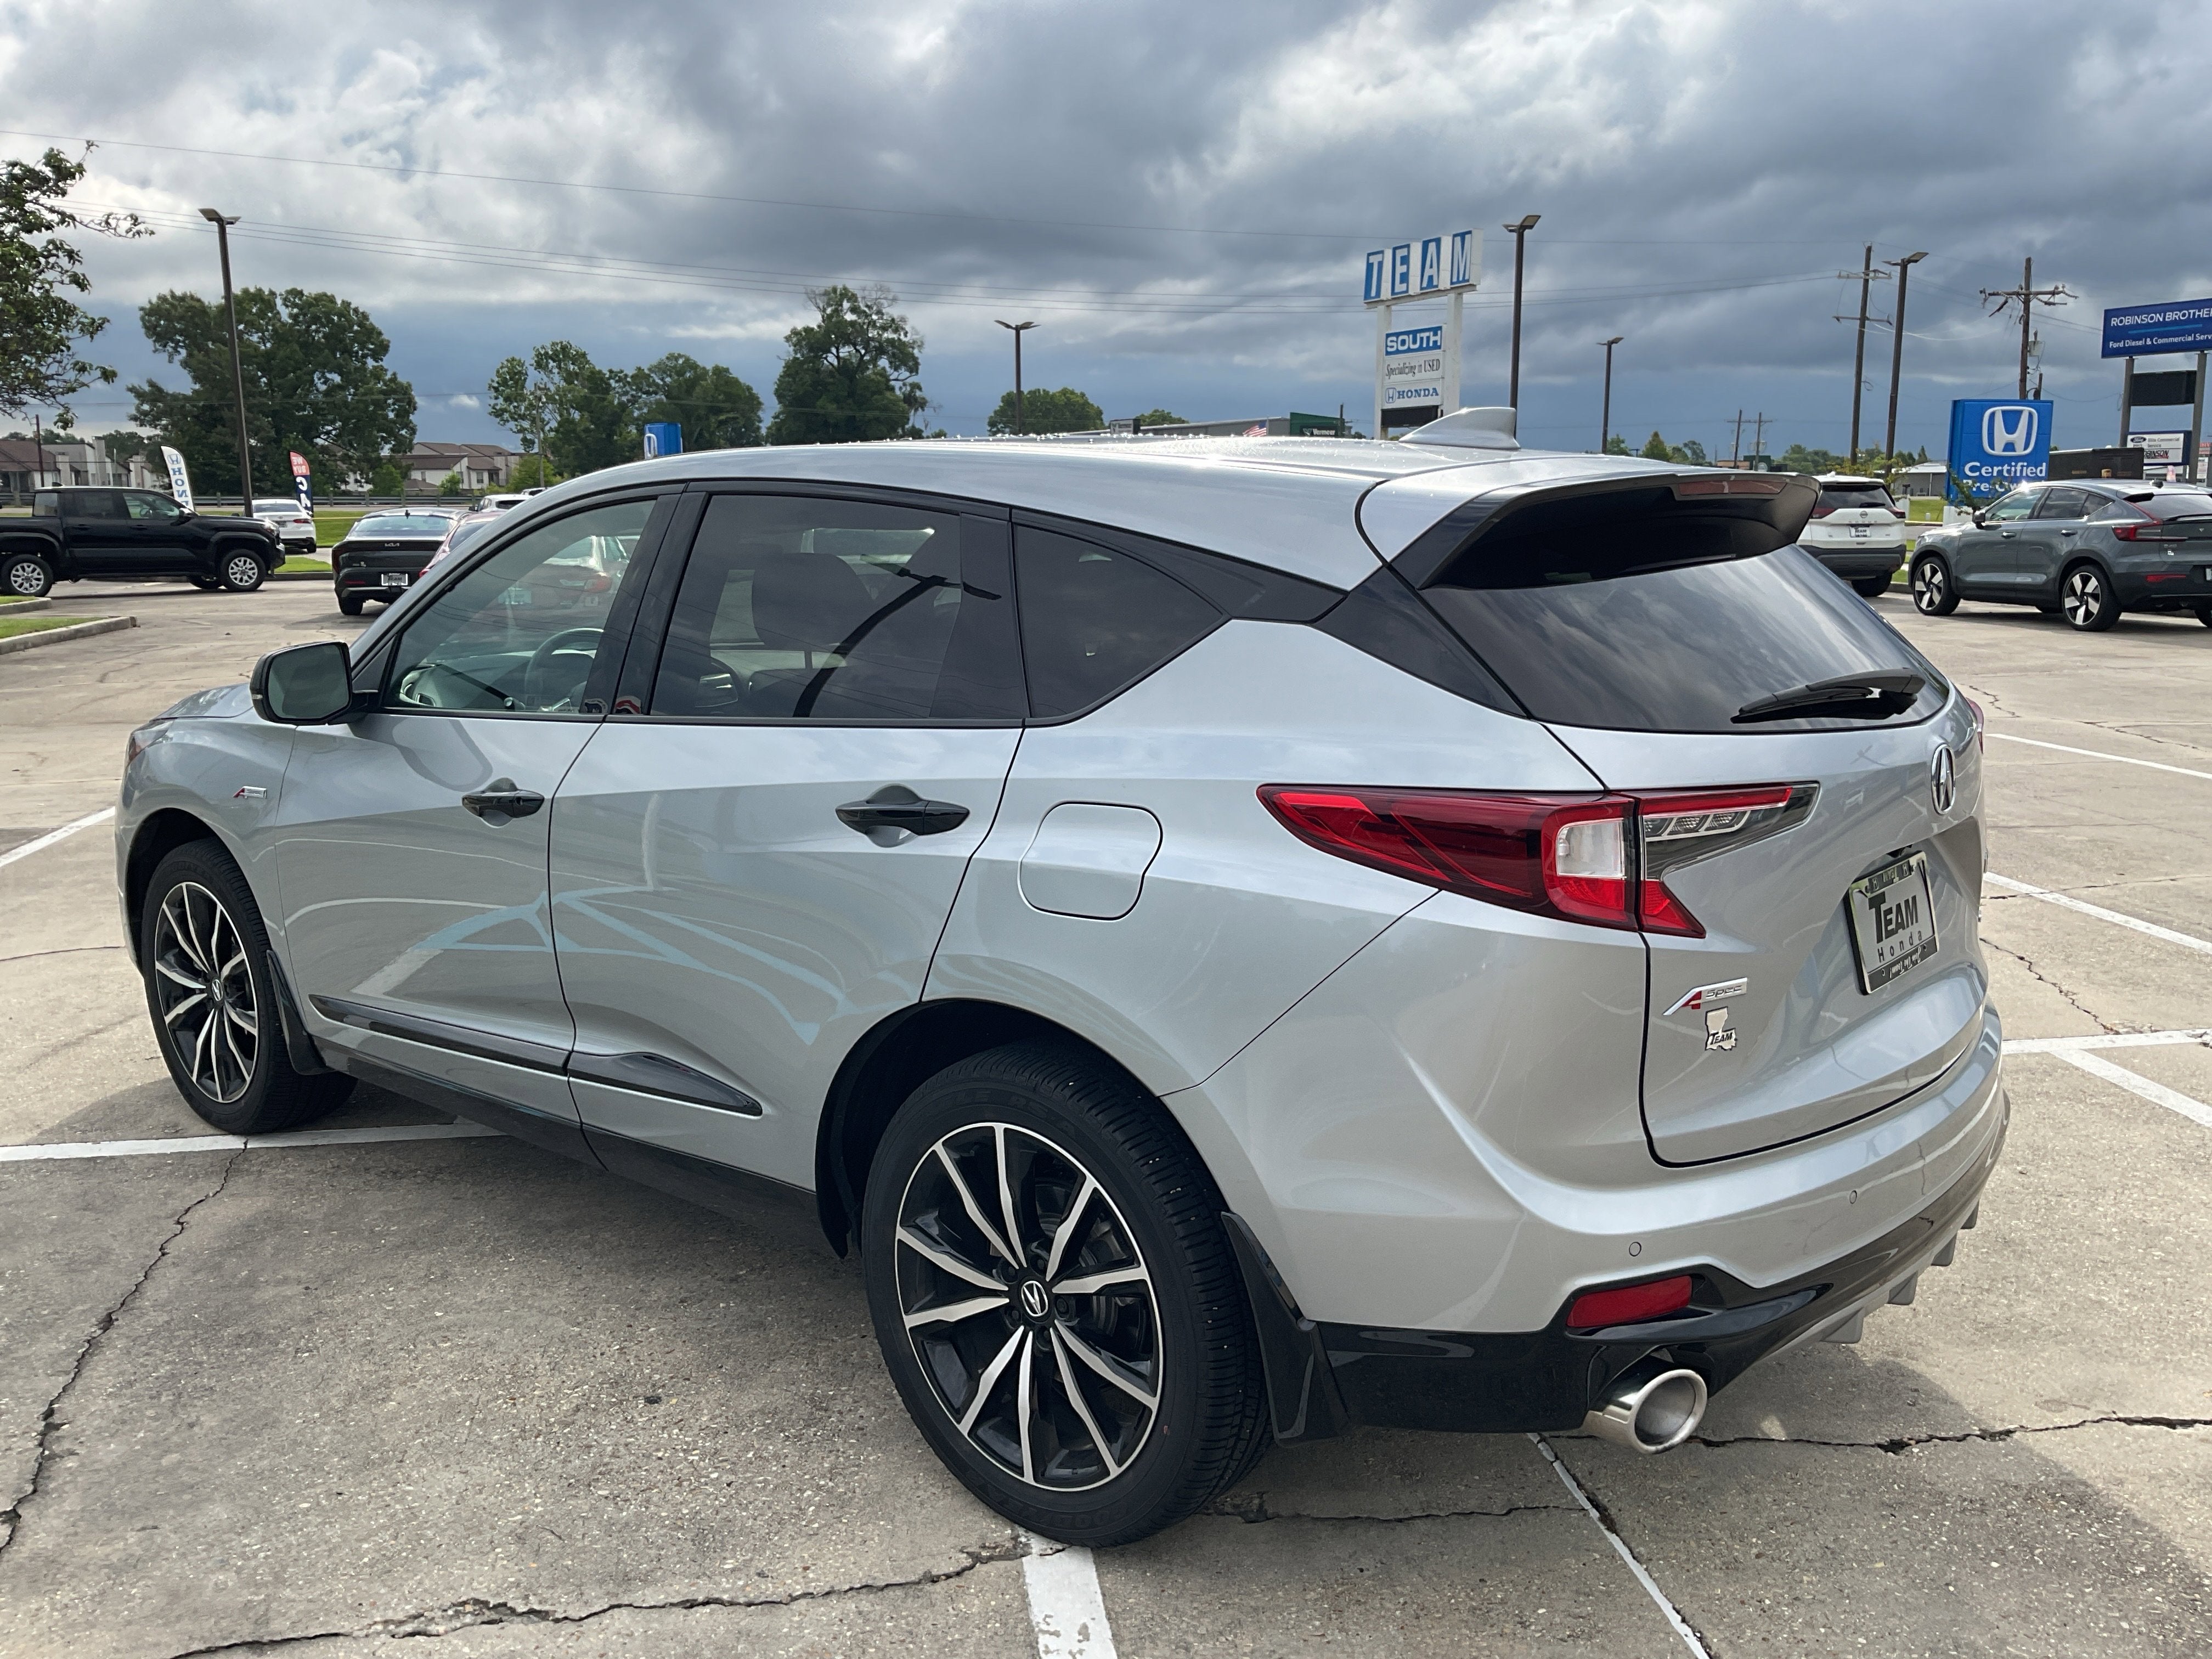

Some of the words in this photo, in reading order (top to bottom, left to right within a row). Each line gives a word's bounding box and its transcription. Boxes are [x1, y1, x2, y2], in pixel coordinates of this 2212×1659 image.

[1369, 234, 1471, 297] TEAM
[2111, 313, 2163, 326] ROBINSON
[1386, 331, 1441, 351] SOUTH
[2109, 340, 2123, 348] Ford
[2125, 338, 2145, 347] Diesel
[2153, 334, 2194, 344] Commercial
[1386, 362, 1417, 380] Specializing
[1418, 360, 1423, 373] in
[1424, 359, 1440, 373] USED
[1397, 387, 1439, 399] HONDA
[1964, 462, 2046, 477] Certified
[1868, 891, 1918, 944] TEAM
[1877, 930, 1922, 963] Honda
[1709, 1031, 1733, 1046] TEAM
